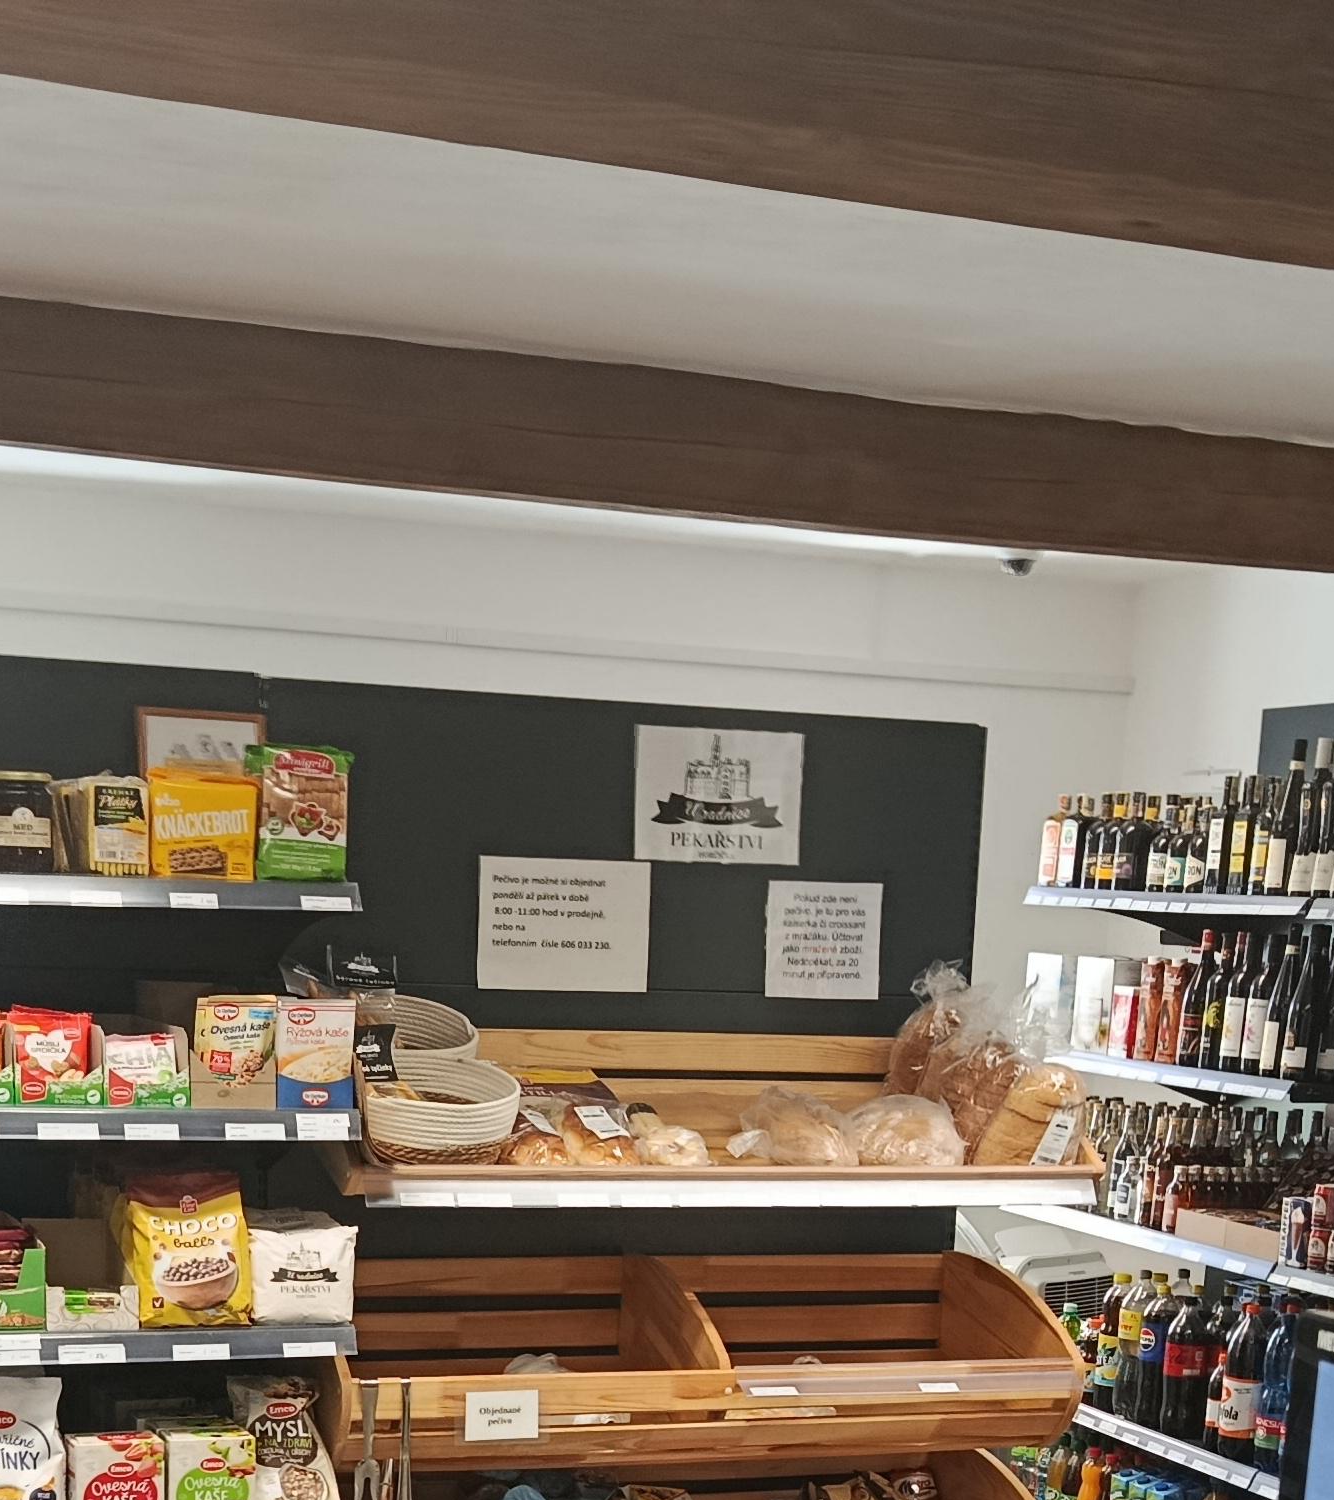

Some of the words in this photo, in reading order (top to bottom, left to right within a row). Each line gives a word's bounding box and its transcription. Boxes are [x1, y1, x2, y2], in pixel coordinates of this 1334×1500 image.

[13, 823, 34, 831] MED
[154, 809, 250, 840] KNÄCKEBROT
[492, 874, 520, 884] Pečivo
[521, 877, 530, 886] je
[531, 876, 559, 885] možné
[569, 879, 606, 888] objednat
[492, 892, 524, 901] pondělí
[525, 892, 535, 900] až
[536, 893, 560, 902] pátek
[568, 894, 589, 903] době
[793, 894, 820, 903] Pokud
[822, 895, 837, 903] zde
[839, 895, 858, 903] není
[494, 907, 513, 915] 8:00
[542, 909, 559, 917] hod
[815, 908, 824, 917] je
[835, 909, 849, 917] pro
[851, 908, 866, 917] vás
[492, 923, 514, 932] nebo
[515, 924, 526, 932] na
[819, 919, 827, 928] či
[828, 920, 866, 929] croissant
[831, 931, 863, 942] Účtovat
[492, 938, 537, 947] telefonním
[541, 939, 559, 949] čísle
[560, 940, 576, 949] 606
[577, 941, 593, 949] 033
[782, 944, 800, 954] jako
[835, 959, 846, 967] za
[848, 959, 859, 967] 20
[782, 970, 806, 978] minut
[807, 971, 815, 980] je
[210, 1024, 247, 1035] Ovesná
[249, 1021, 271, 1032] kaše
[286, 1026, 322, 1038] Rýžová
[325, 1026, 349, 1037] kaše
[107, 1046, 173, 1066] CHIA
[148, 1212, 238, 1237] CHOCO
[173, 1236, 215, 1249] balls
[269, 1405, 297, 1415] Emco
[479, 1405, 522, 1417] Objednané
[487, 1416, 513, 1427] pečivo
[110, 1464, 133, 1474] Emco
[202, 1461, 225, 1469] Emco
[91, 1478, 150, 1496] Ovesná
[184, 1476, 241, 1491] Ovesná
